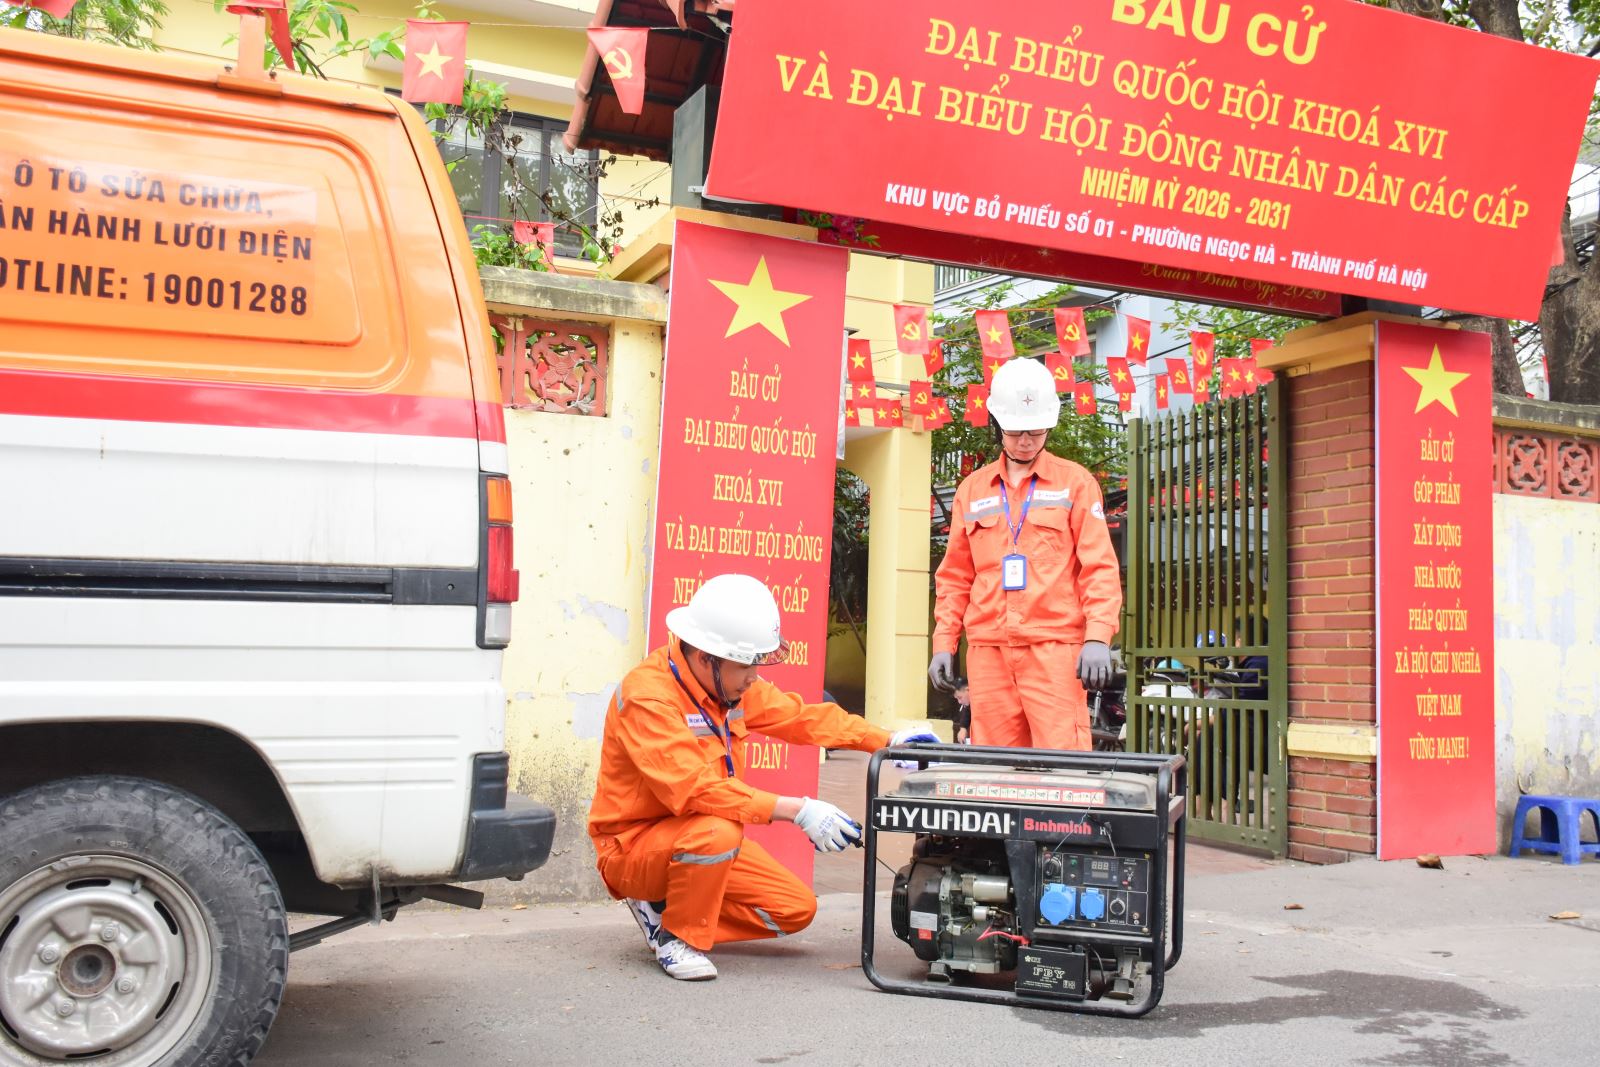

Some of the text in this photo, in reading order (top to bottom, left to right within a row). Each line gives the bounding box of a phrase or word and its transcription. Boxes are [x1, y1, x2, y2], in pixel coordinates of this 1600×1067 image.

[1246, 4, 1327, 65] CỬ
[925, 18, 1448, 160] ĐẠI BIỂU QUỐC HỘI KHOÁ XVI
[775, 51, 1529, 230] VÀ ĐẠI BIỂU HỘI ĐỒNG NHÂN DÂN CÁC CẤP
[14, 159, 34, 187] Ô
[48, 160, 87, 193] TÔ
[1080, 165, 1148, 208] NHIỆM
[1153, 176, 1181, 211] KỲ
[1181, 184, 1230, 219] 2026
[1246, 199, 1292, 231] 2031
[48, 208, 140, 242] HÀNH
[154, 222, 226, 252] LƯỚI
[238, 229, 312, 264] ĐIỆN
[885, 183, 929, 206] KHU
[931, 191, 970, 216] VỰC
[974, 194, 1000, 220] BỎ
[1005, 203, 1061, 229] PHIẾU
[1065, 210, 1092, 234] SỐ
[1093, 219, 1114, 238] 01
[1131, 225, 1203, 253] PHƯỜNG
[1205, 235, 1250, 263] NGỌC
[1253, 240, 1276, 266] HÀ
[1291, 250, 1342, 276] THÀNH
[1344, 258, 1376, 281] PHỐ
[1376, 263, 1399, 284] HÀ
[1400, 268, 1428, 291] NỘI
[143, 272, 308, 316] 19001288
[729, 357, 782, 402] BẦU CỬ
[684, 405, 817, 464] ĐẠI BIỂU QUỐC HỘI
[712, 468, 783, 507] KHOÁ XVI
[1413, 474, 1433, 503] GÓP
[665, 511, 823, 565] VÀ ĐẠI BIỂU HỘI ĐỒNG
[1413, 516, 1461, 552] XÂY DỰNG
[782, 574, 809, 613] CẤP
[1414, 560, 1462, 589] NHÀ NƯỚC
[1408, 602, 1434, 630] PHÁP
[1411, 645, 1429, 679] HỘI
[1430, 641, 1450, 674] CHỦ
[1416, 687, 1462, 722] VIỆT NAM
[880, 805, 1011, 835] HYUNDAI
